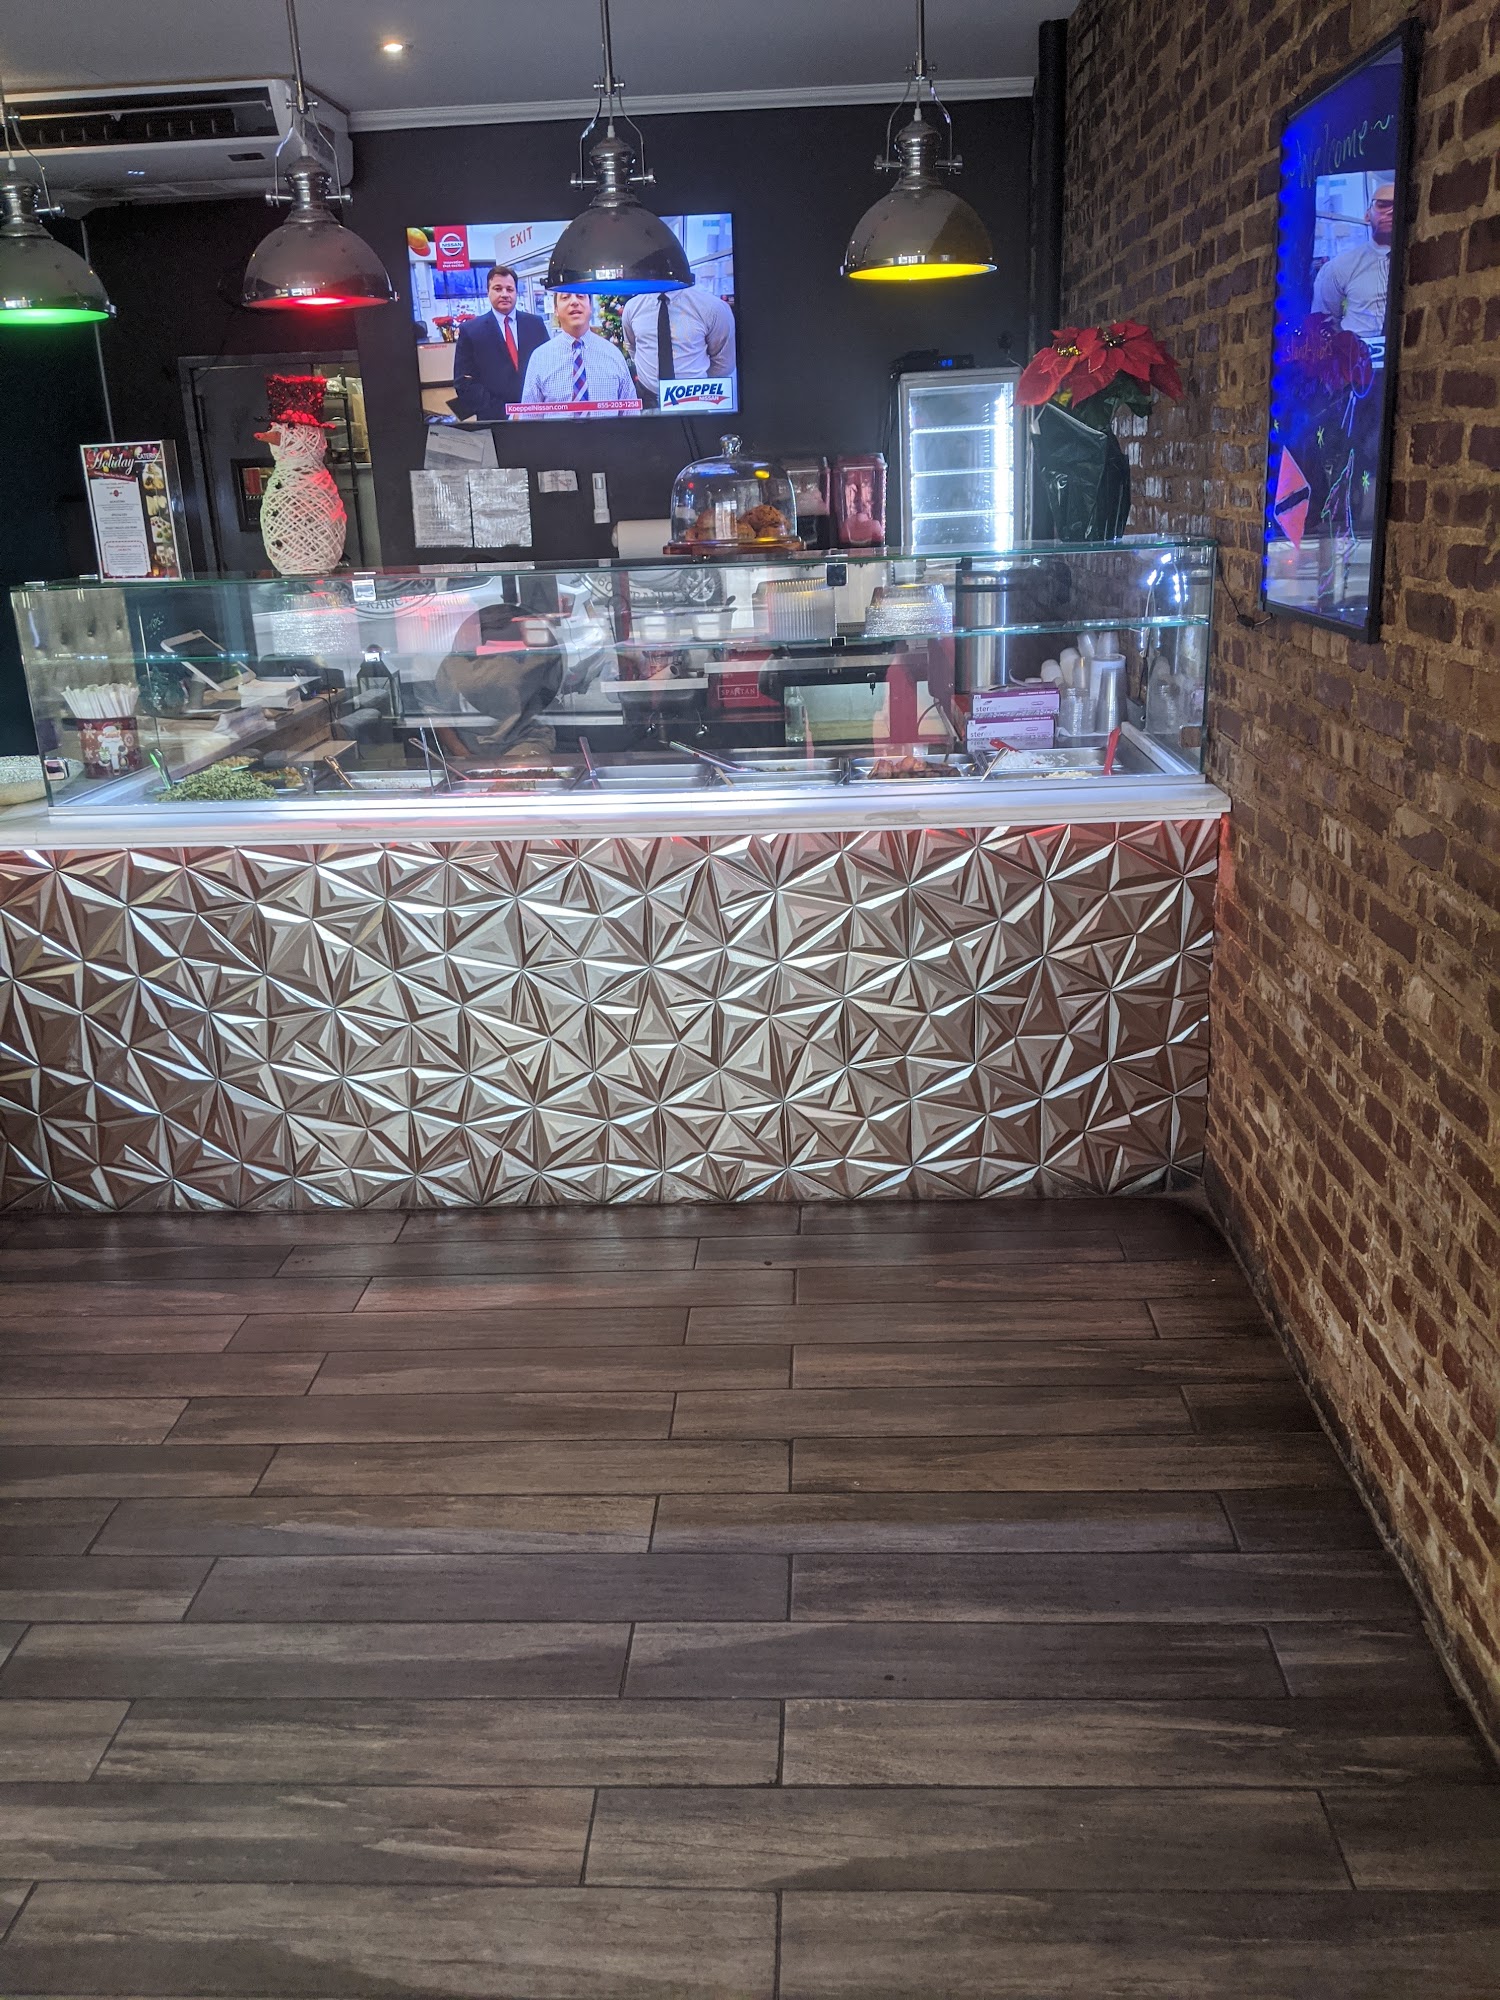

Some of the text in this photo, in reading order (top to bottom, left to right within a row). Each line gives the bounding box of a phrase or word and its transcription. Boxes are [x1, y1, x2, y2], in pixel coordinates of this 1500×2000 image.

[510, 226, 533, 248] EXIT
[663, 383, 724, 406] KOEPPEL
[508, 403, 568, 413] KoeppelNissan.com
[88, 450, 135, 475] Holiday
[721, 687, 755, 697] SPARTAN
